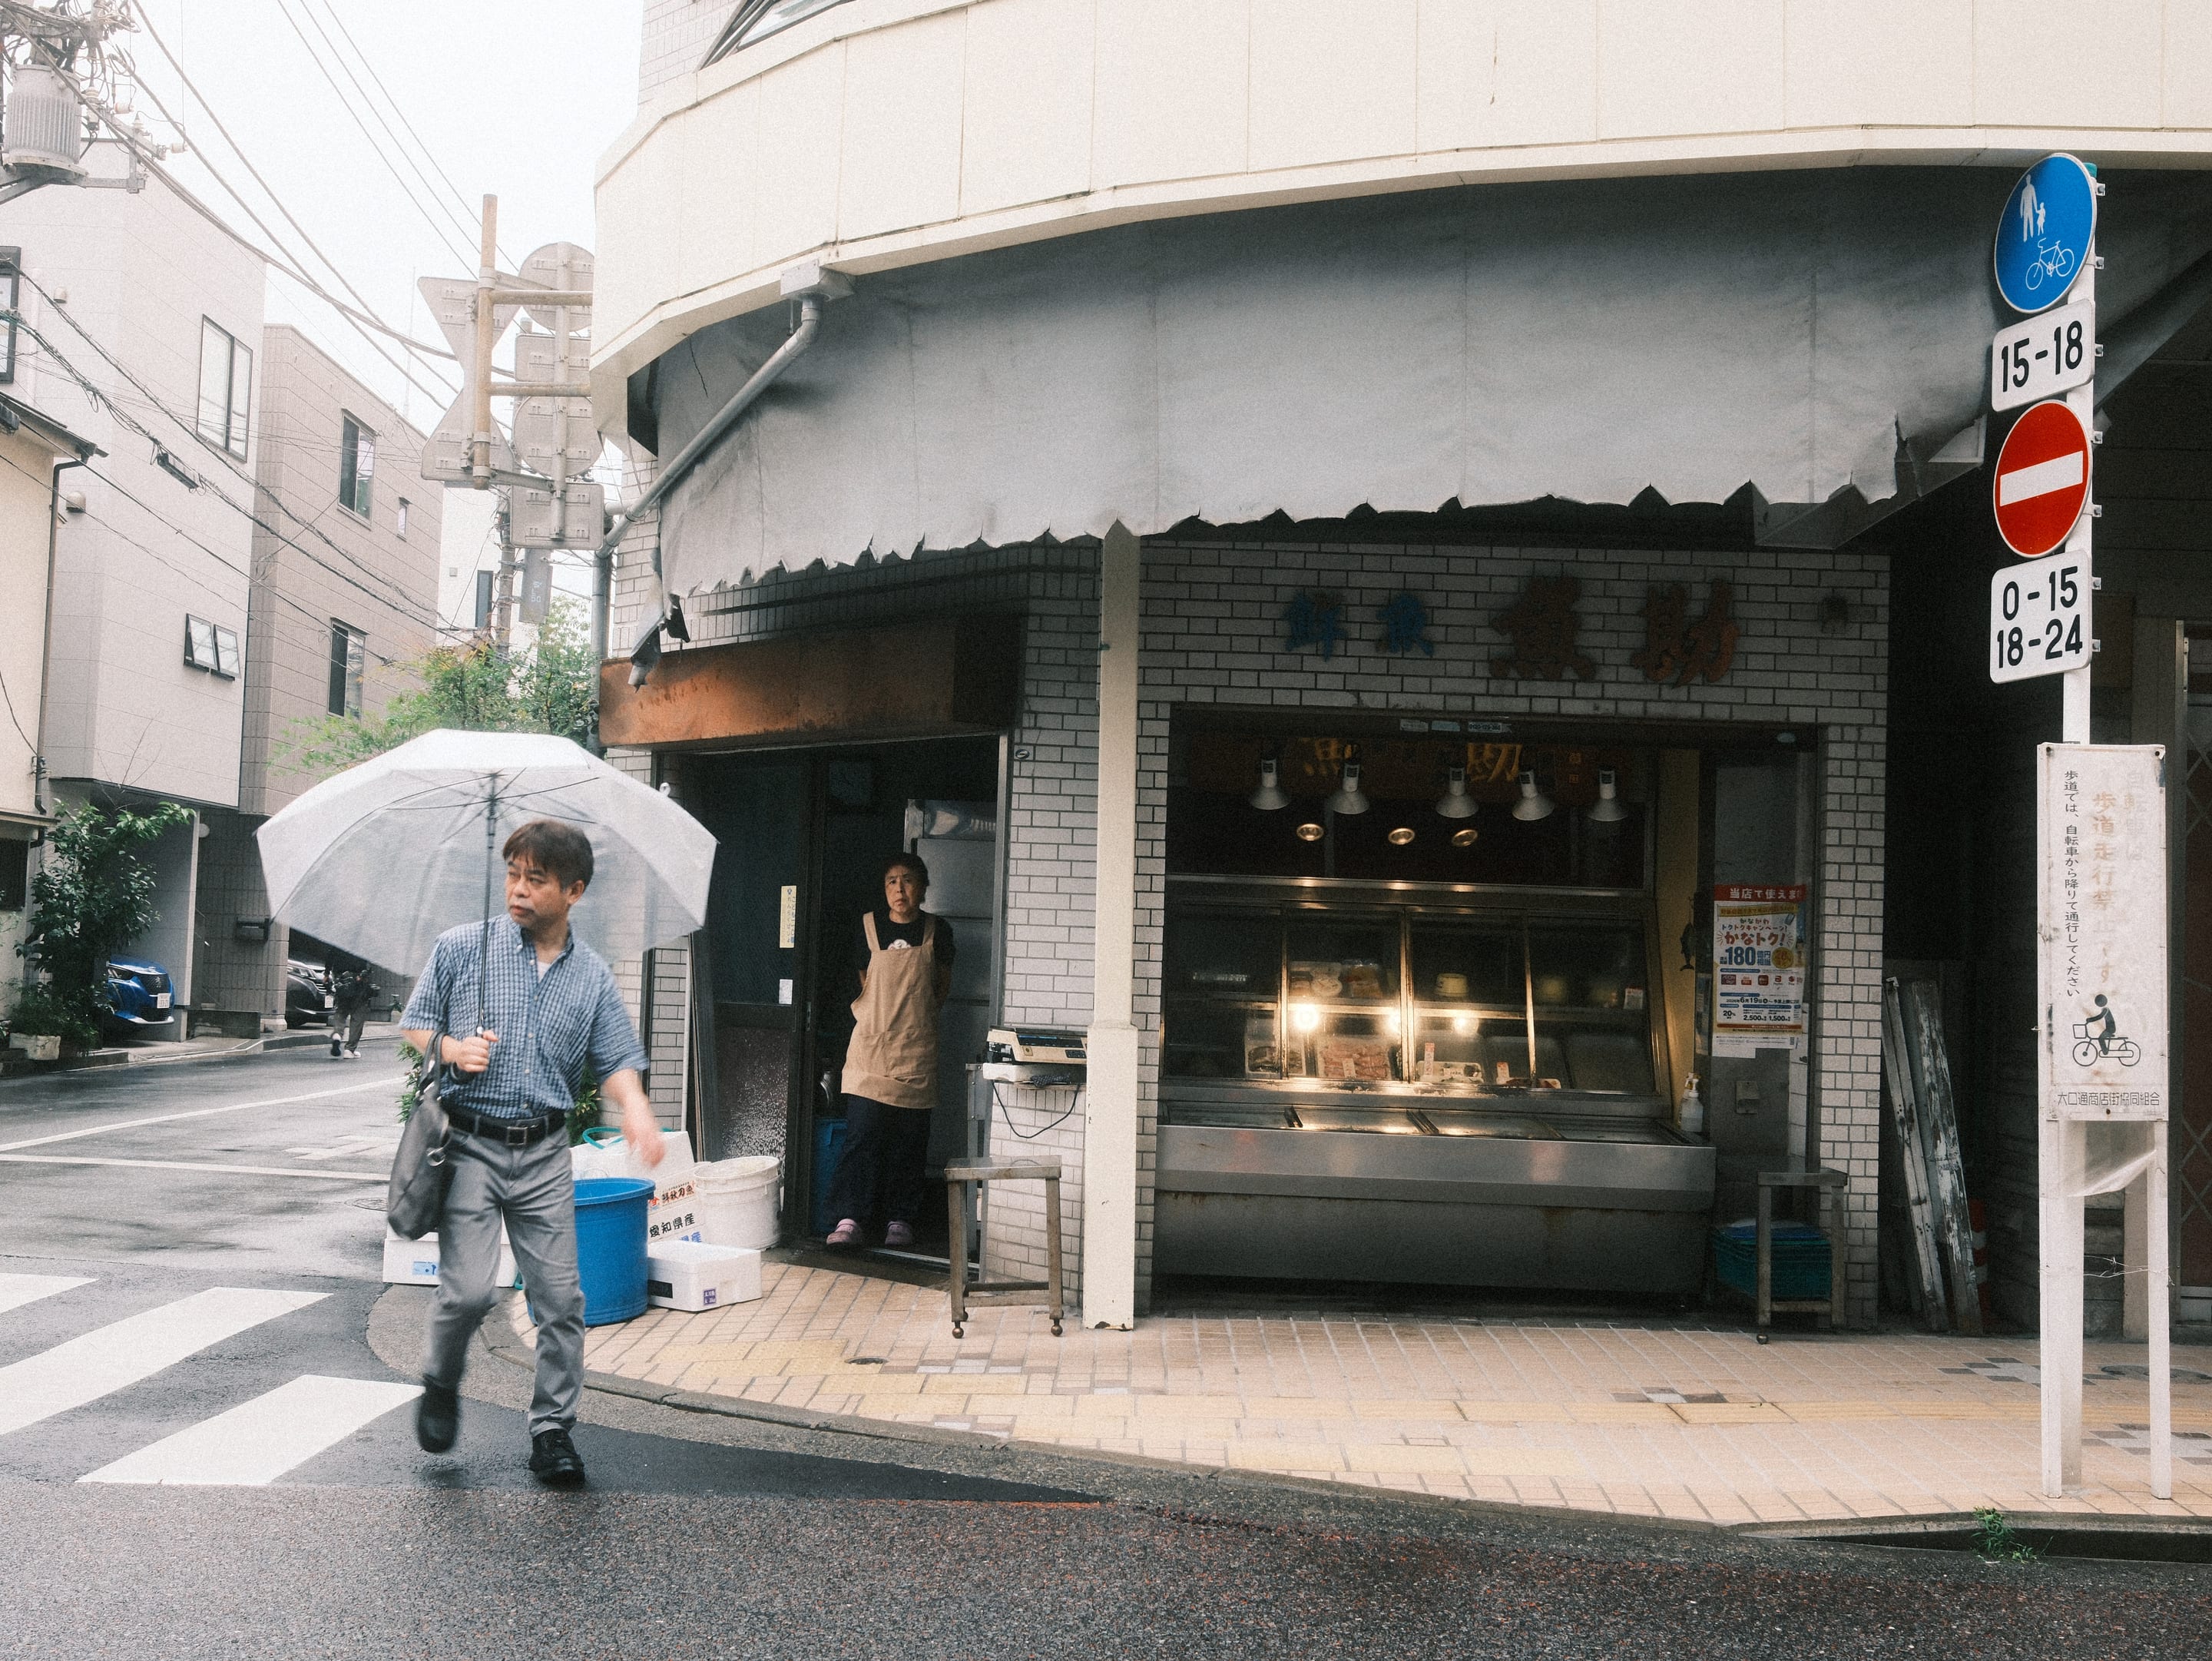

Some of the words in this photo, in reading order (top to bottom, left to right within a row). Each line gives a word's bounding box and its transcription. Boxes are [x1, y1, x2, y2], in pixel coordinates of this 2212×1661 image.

[2001, 320, 2083, 393] 15-18
[2002, 565, 2078, 621] 0-15
[1997, 614, 2083, 669] 18-24
[1726, 947, 1757, 966] 180
[2057, 1092, 2161, 1106] 大口通商店街協同組合
[649, 1213, 695, 1238] 愛知県産
